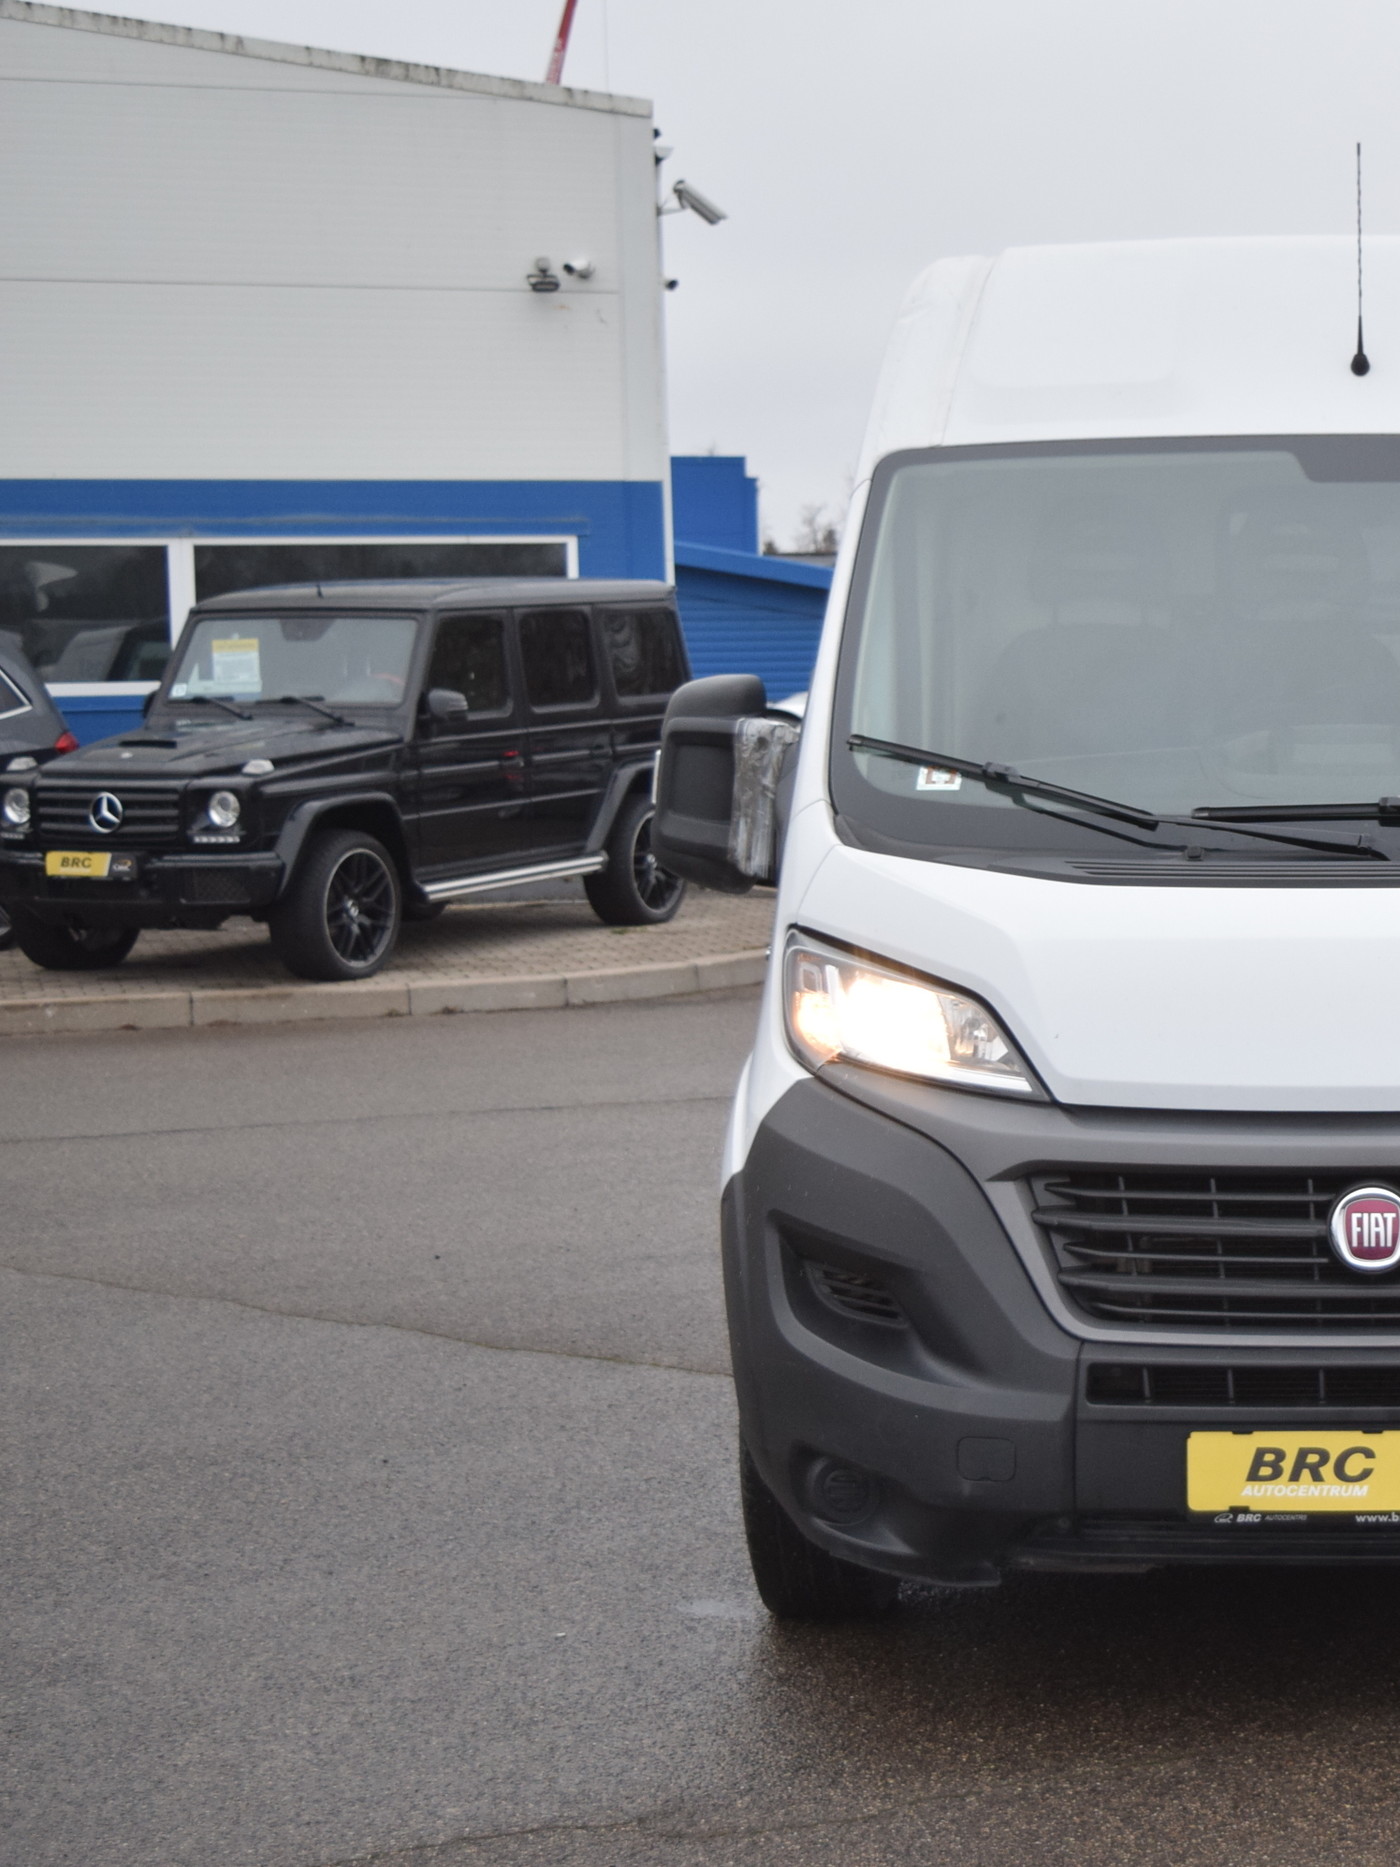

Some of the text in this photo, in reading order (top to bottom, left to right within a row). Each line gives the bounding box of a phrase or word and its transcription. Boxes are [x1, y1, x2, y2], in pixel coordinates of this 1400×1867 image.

[61, 857, 92, 868] BRC
[1351, 1212, 1396, 1248] FIAT
[1245, 1446, 1376, 1483] BRC
[1241, 1484, 1369, 1497] AUTOCENTRUM
[1236, 1513, 1262, 1523] BRC
